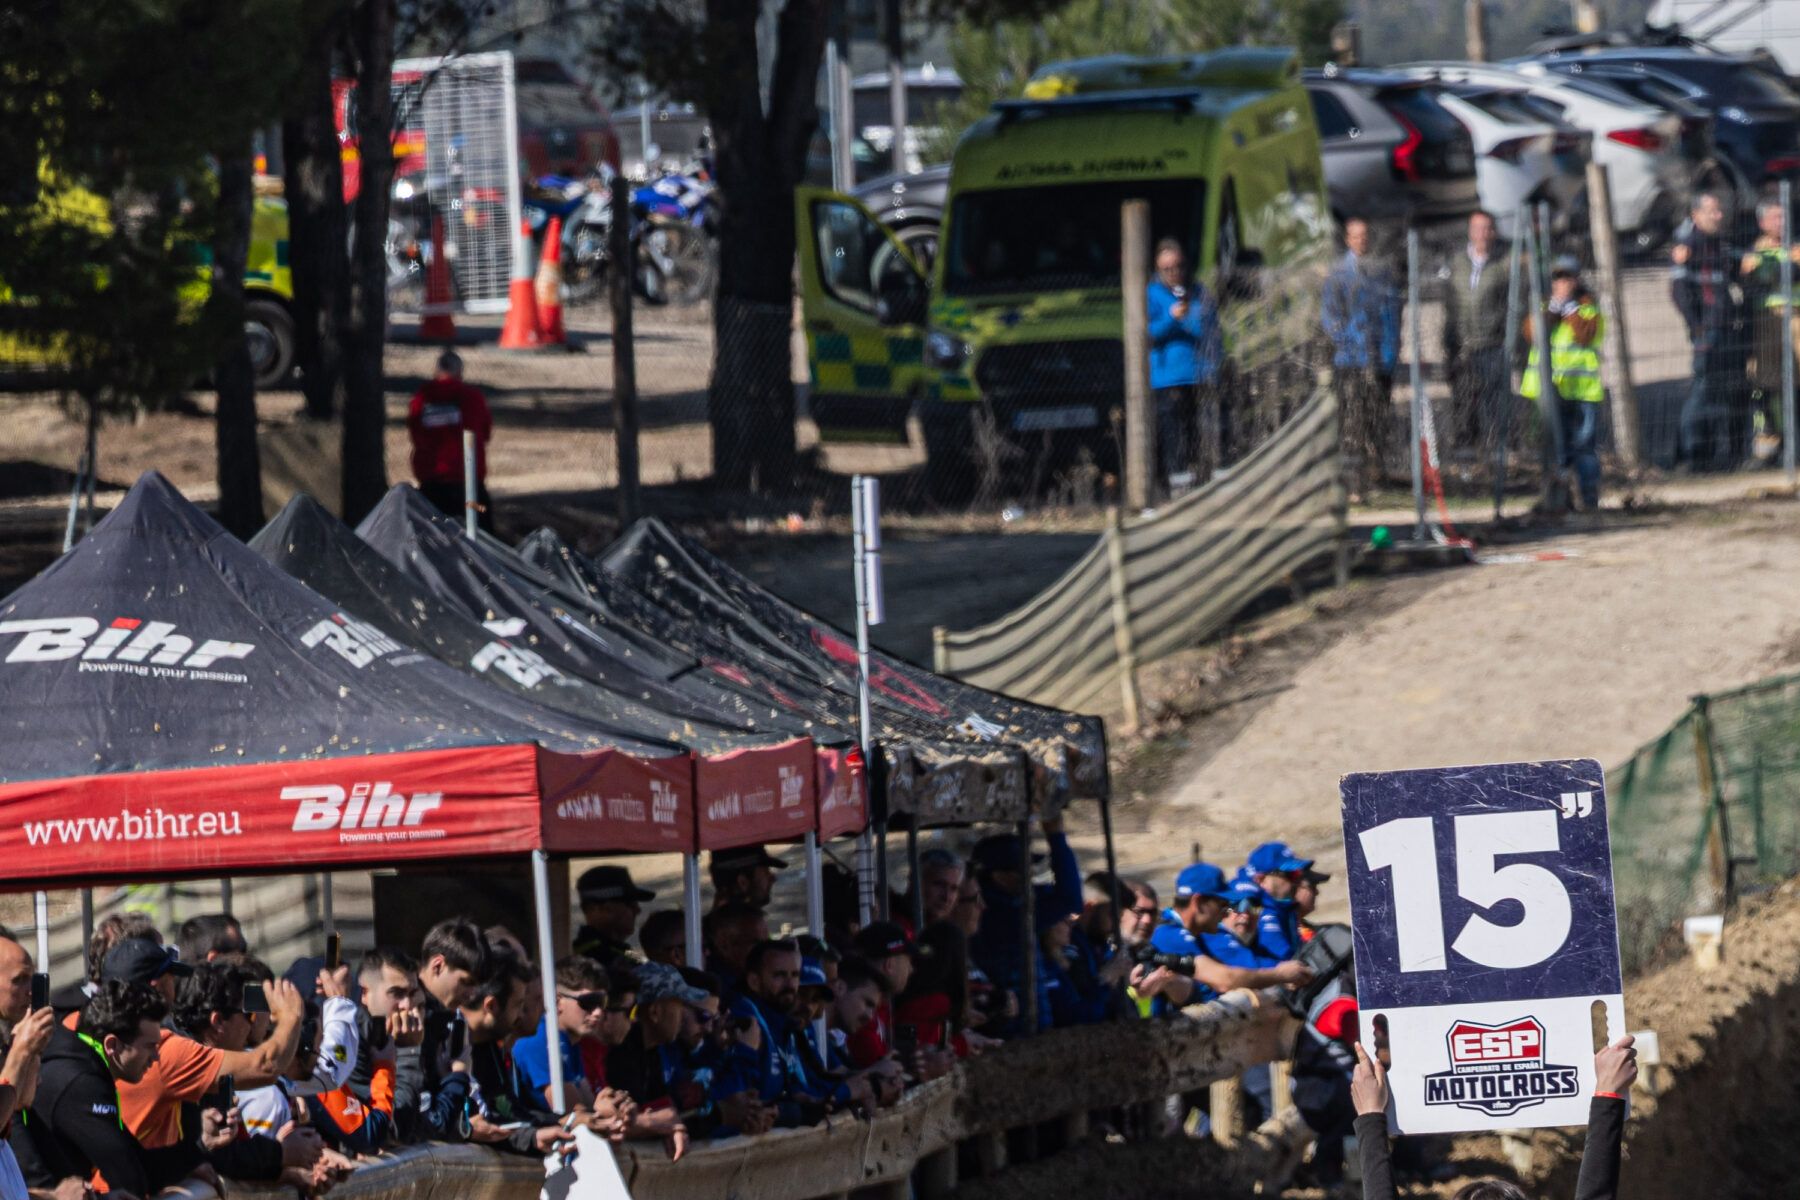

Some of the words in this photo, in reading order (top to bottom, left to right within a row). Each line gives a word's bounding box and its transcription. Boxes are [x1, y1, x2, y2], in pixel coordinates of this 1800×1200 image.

[0, 617, 255, 668] Bihr
[79, 660, 149, 677] Powering
[151, 666, 187, 679] your
[190, 670, 248, 684] passion
[280, 781, 443, 832] Bihr
[23, 809, 242, 845] www.bihr.eu
[339, 832, 383, 843] Powering
[385, 832, 407, 842] your
[409, 829, 446, 840] passion
[1454, 1029, 1539, 1060] ESP
[1502, 1063, 1512, 1071] DE
[1514, 1060, 1540, 1070] ESPAÑA
[1428, 1070, 1576, 1101] MOTOCROSS
